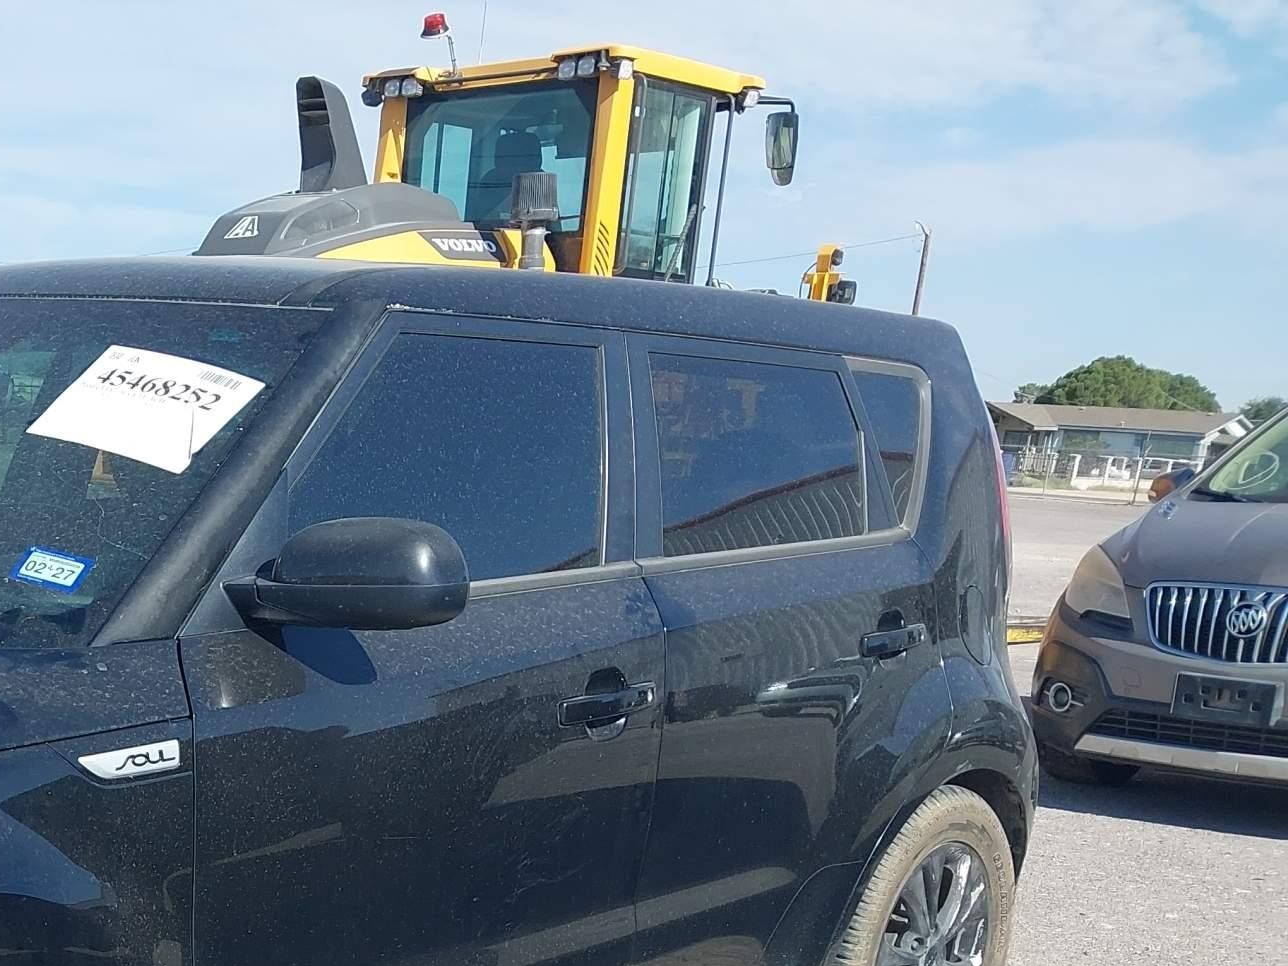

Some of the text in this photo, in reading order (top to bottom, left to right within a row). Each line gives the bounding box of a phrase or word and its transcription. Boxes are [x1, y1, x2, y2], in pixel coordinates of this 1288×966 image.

[431, 238, 497, 253] VOLVO
[96, 368, 222, 411] 45468252
[24, 560, 48, 575] 02
[50, 567, 76, 581] 27
